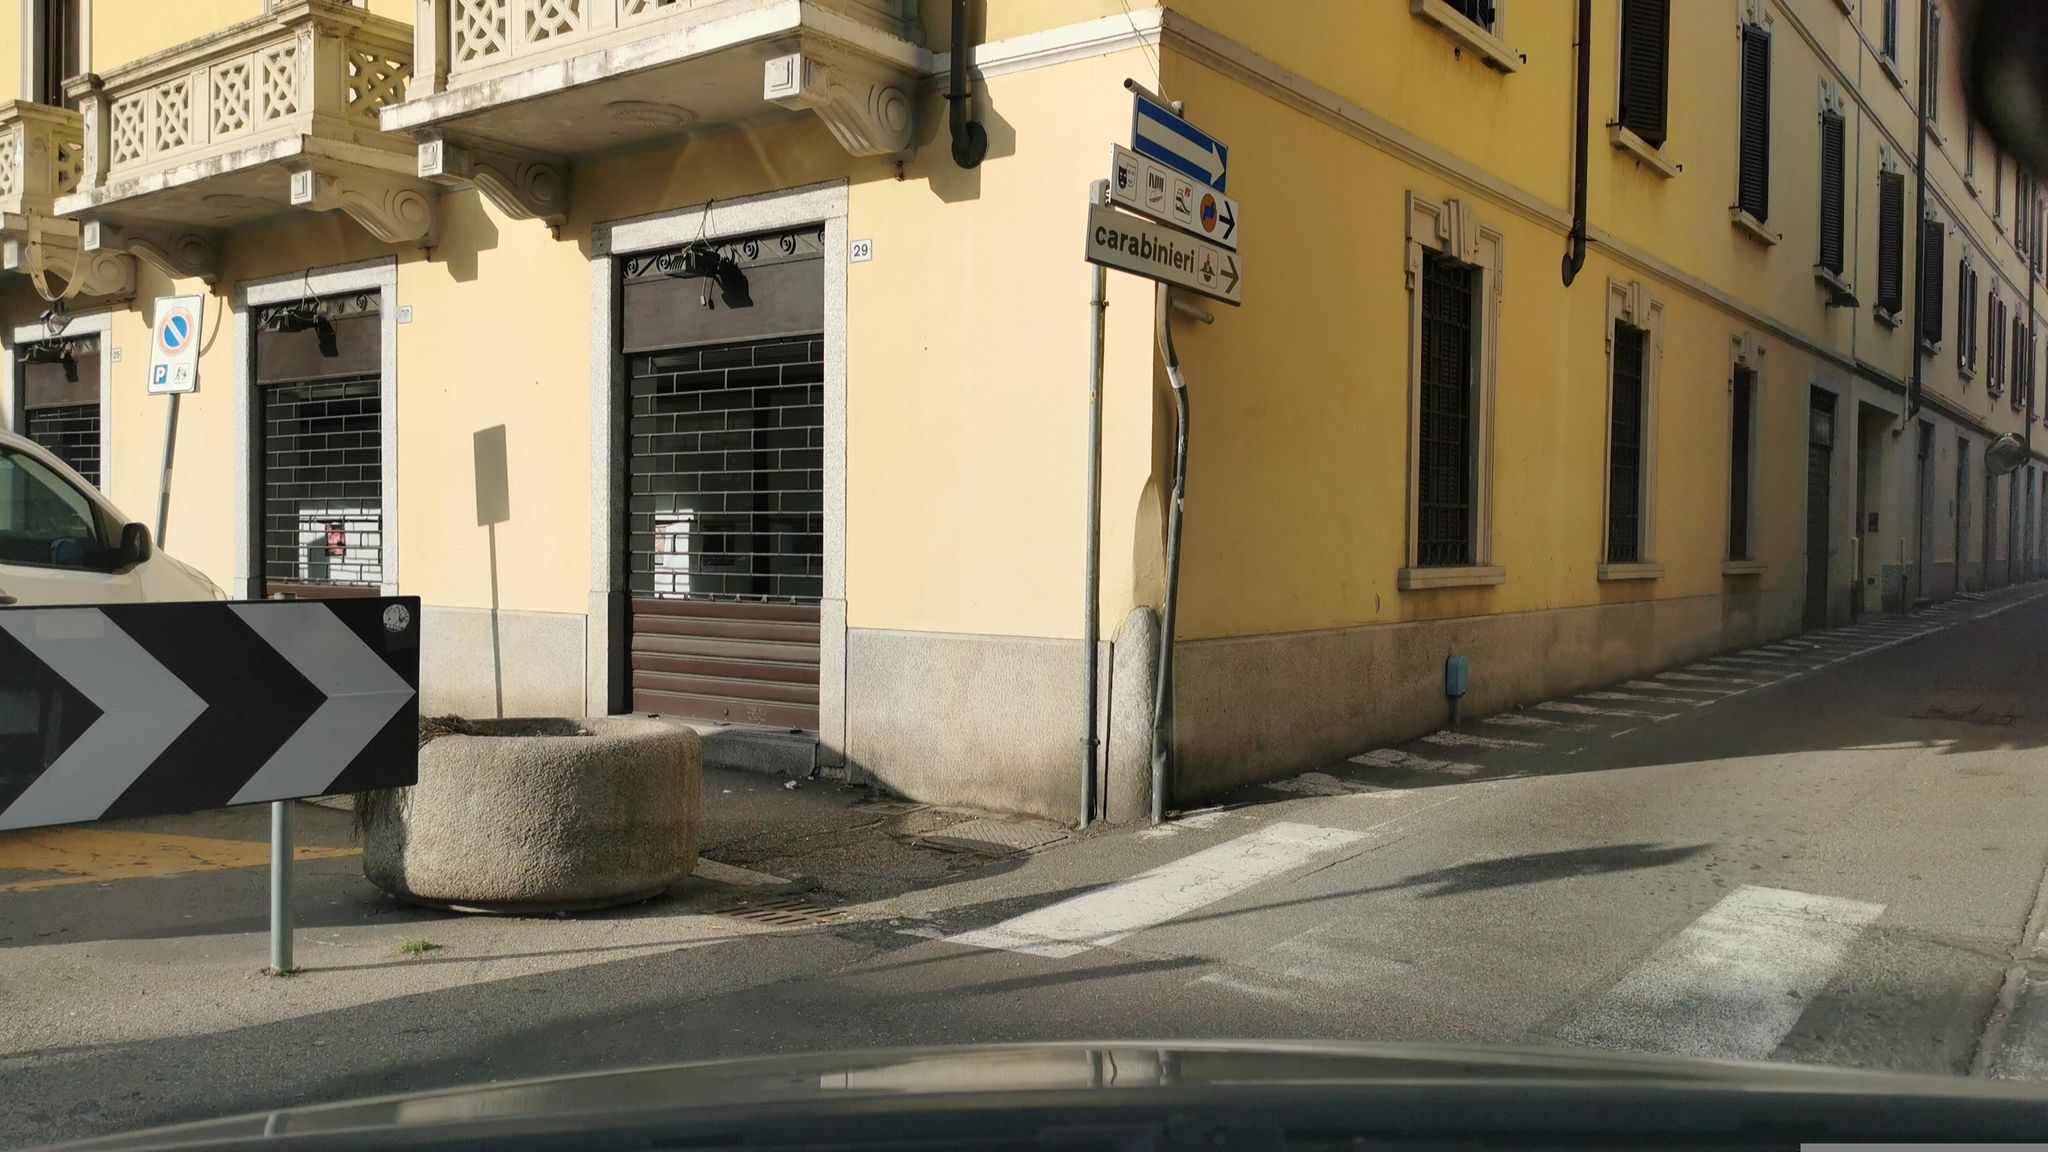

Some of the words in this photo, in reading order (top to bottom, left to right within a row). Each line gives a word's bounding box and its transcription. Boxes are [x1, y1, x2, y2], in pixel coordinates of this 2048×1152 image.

[853, 243, 868, 257] 29
[1095, 225, 1195, 273] carabinieri
[155, 366, 166, 383] P
